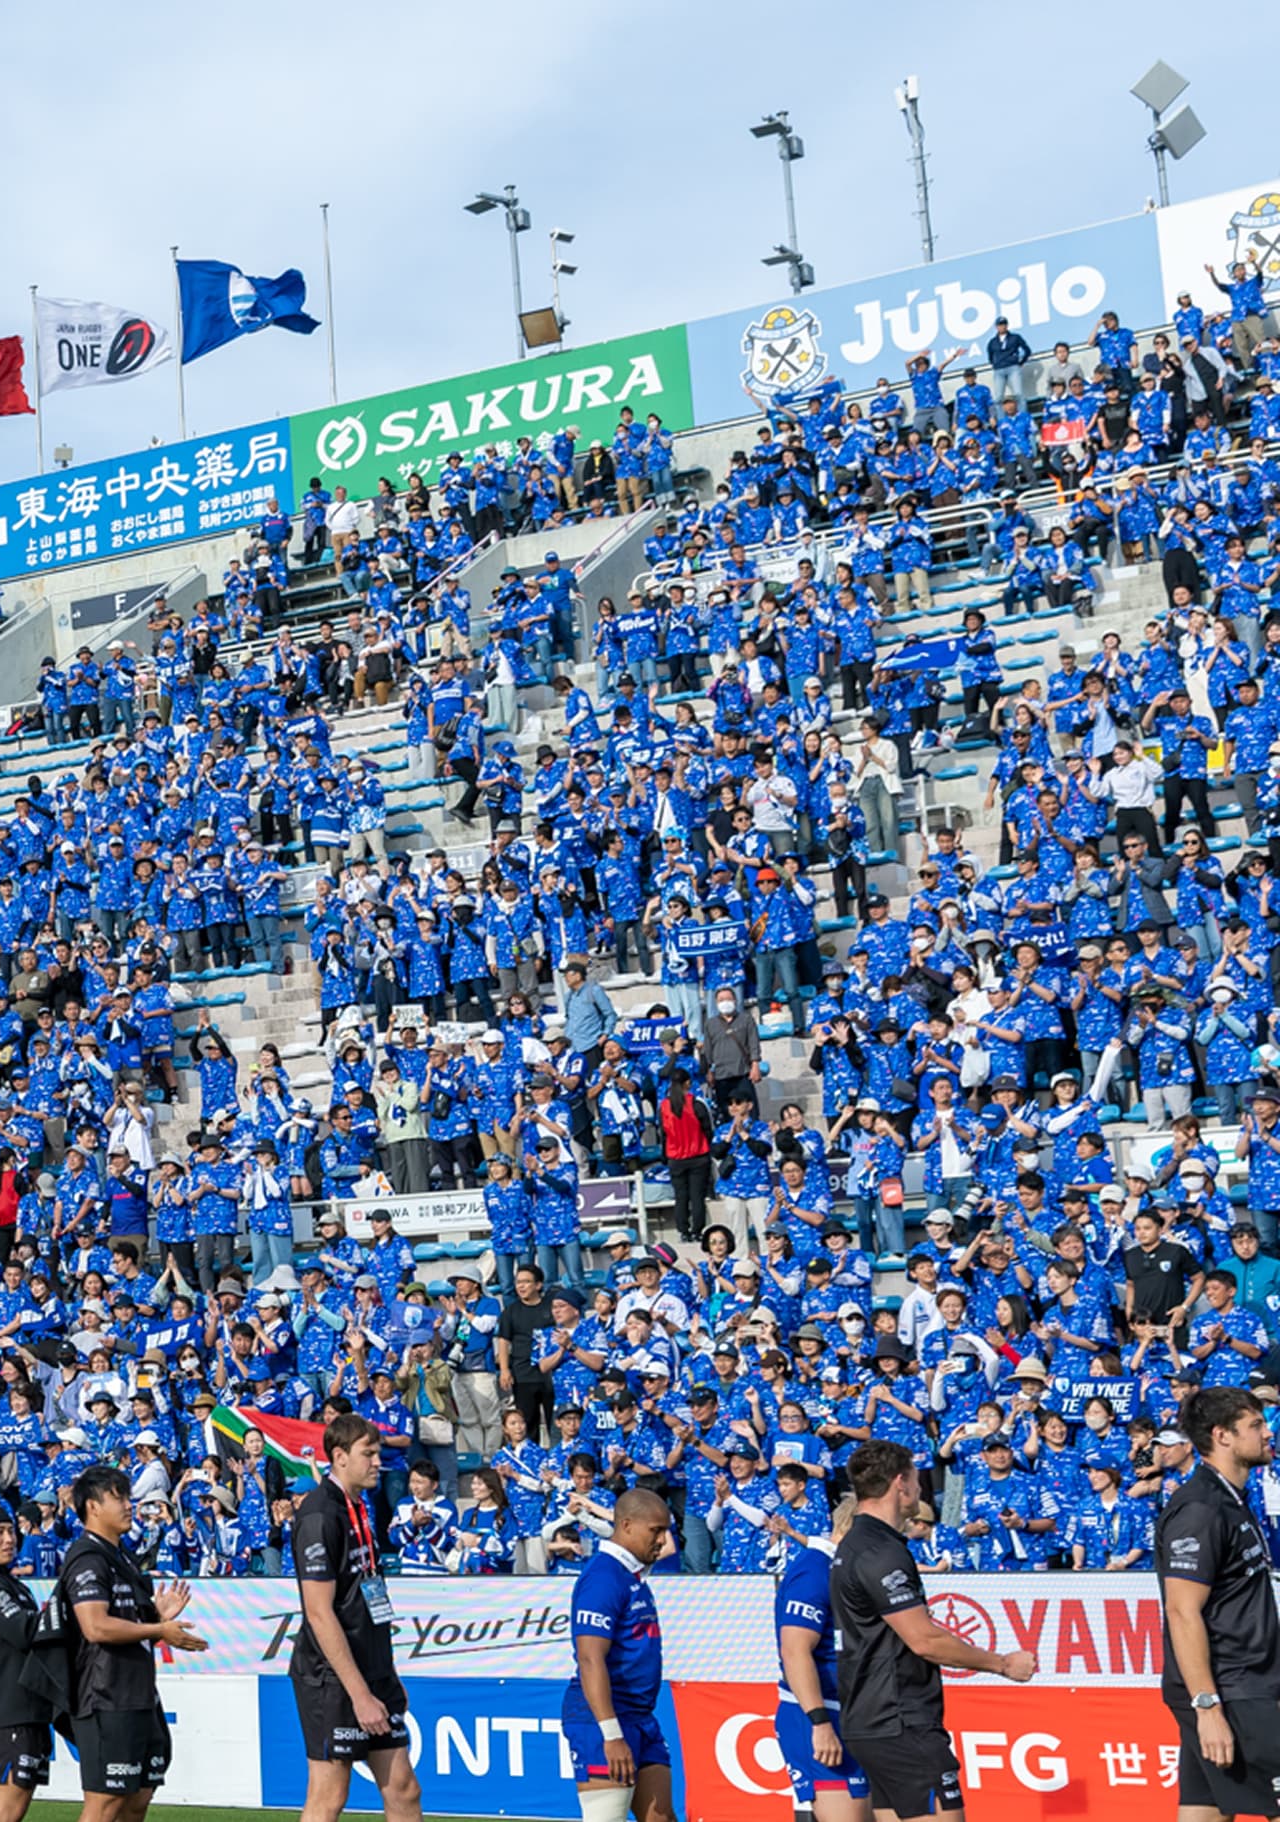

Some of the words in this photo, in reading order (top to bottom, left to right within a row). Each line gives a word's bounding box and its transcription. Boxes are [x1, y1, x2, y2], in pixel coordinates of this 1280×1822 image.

[840, 262, 1106, 364] Júbilo
[57, 338, 102, 371] ONE
[375, 354, 664, 457] SAKURA
[11, 431, 288, 531] 東海中央薬局
[114, 593, 127, 611] F
[408, 1614, 514, 1659] Your
[576, 1609, 612, 1631] ITEC
[785, 1600, 824, 1624] ITEC
[1001, 1599, 1164, 1675] YAM
[435, 1716, 576, 1779] NTT
[949, 1731, 1071, 1794] FG
